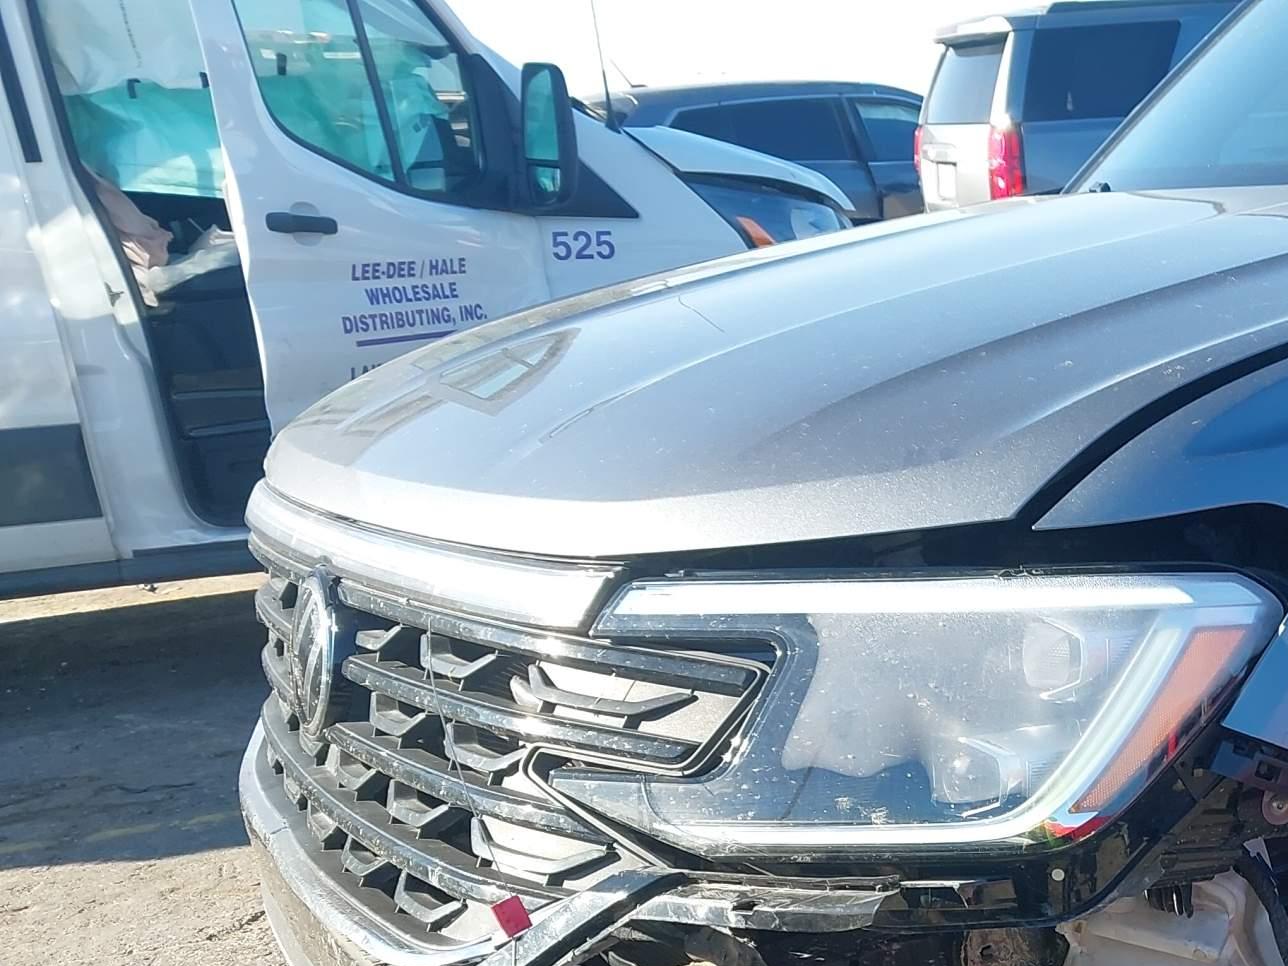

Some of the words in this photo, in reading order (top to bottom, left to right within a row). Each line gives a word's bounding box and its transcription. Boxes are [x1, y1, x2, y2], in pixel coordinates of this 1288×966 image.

[551, 230, 616, 261] 525
[351, 260, 416, 281] LEE-DEE
[429, 257, 467, 276] HALE
[364, 281, 459, 306] WHOLESALE
[341, 307, 456, 335] DISTRIBUTING,
[459, 303, 488, 322] INC.
